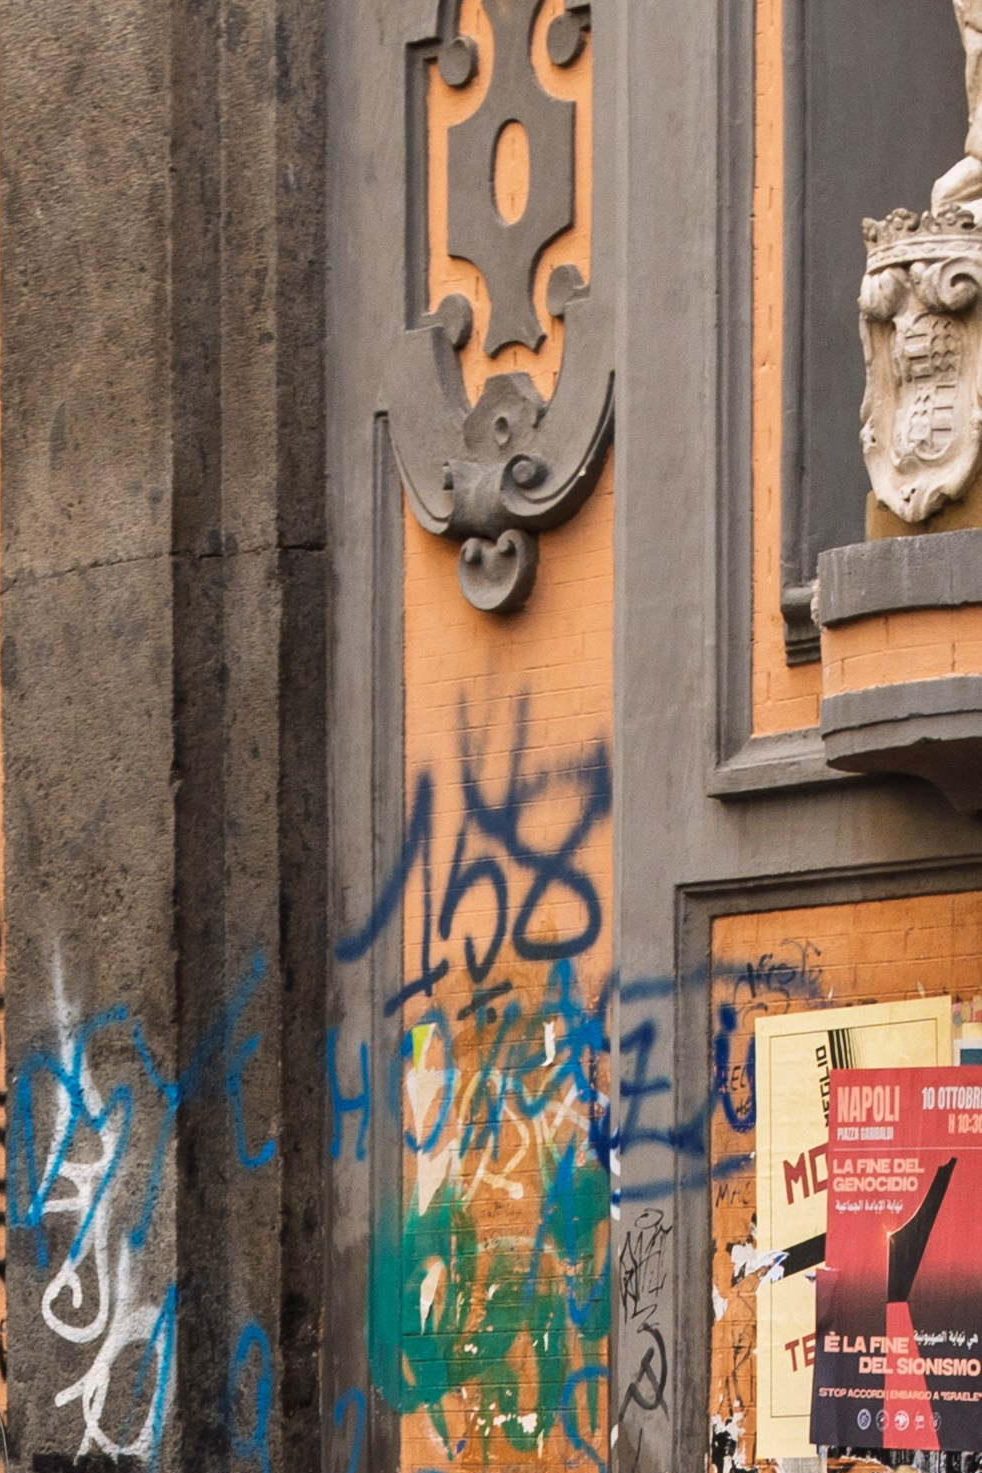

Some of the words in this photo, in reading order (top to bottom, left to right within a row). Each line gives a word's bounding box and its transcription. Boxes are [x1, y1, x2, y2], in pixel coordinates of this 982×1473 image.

[837, 1085, 900, 1123] NAPOLI
[922, 1087, 935, 1110] 10
[837, 1126, 859, 1141] PIAZZA
[948, 1114, 956, 1134] H
[833, 1159, 854, 1174] LA
[857, 1159, 891, 1174] FINE
[893, 1158, 925, 1174] DEL
[833, 1176, 918, 1192] GENOCIDIO
[824, 1331, 840, 1353] È
[843, 1335, 867, 1353] LA
[870, 1336, 910, 1354] FINE
[859, 1356, 894, 1374] DEL
[897, 1357, 981, 1377] SIONISMO
[819, 1387, 847, 1398] STOP
[848, 1388, 885, 1399] ACCORDI
[890, 1390, 931, 1400] EMBARGO
[933, 1391, 939, 1400] A
